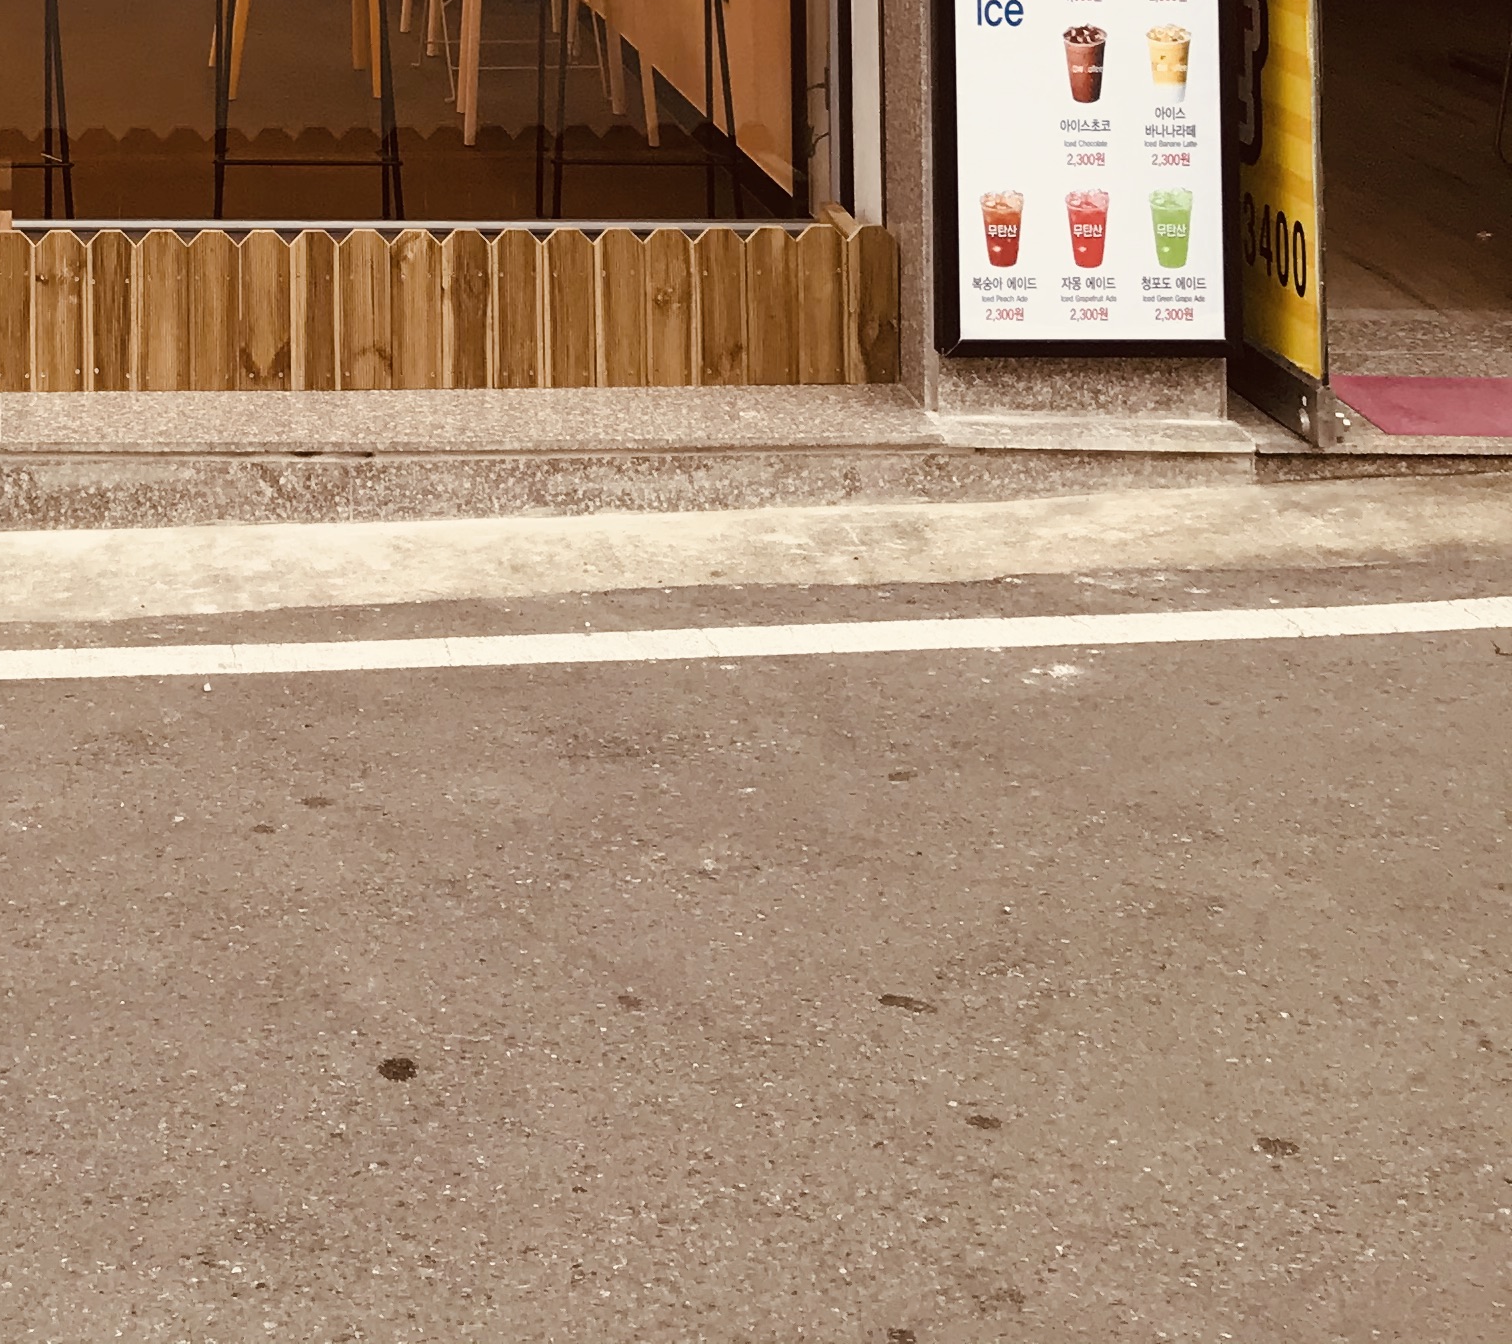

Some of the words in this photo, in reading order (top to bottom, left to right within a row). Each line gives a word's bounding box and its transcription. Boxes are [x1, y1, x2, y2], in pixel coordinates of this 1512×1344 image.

[1154, 106, 1186, 120] 아이스
[1060, 119, 1111, 133] 아이스초코
[1145, 124, 1196, 138] 바나나라떼
[1067, 153, 1106, 166] 2,300원
[1151, 153, 1190, 166] 2,300원
[988, 224, 1018, 238] 무탄산
[1073, 224, 1103, 238] 무탄산
[1156, 224, 1187, 238] 무탄산
[1243, 191, 1307, 298] 3400
[972, 277, 1003, 290] 복숭아
[1006, 277, 1037, 290] 에이드
[1061, 277, 1082, 290] 자몽
[1085, 277, 1116, 290] 에이드
[1141, 277, 1172, 290] 청포도
[1175, 277, 1207, 290] 에이드
[985, 308, 1024, 321] 2,300원
[1070, 308, 1109, 321] 2,300원
[1155, 308, 1194, 321] 2,300원
